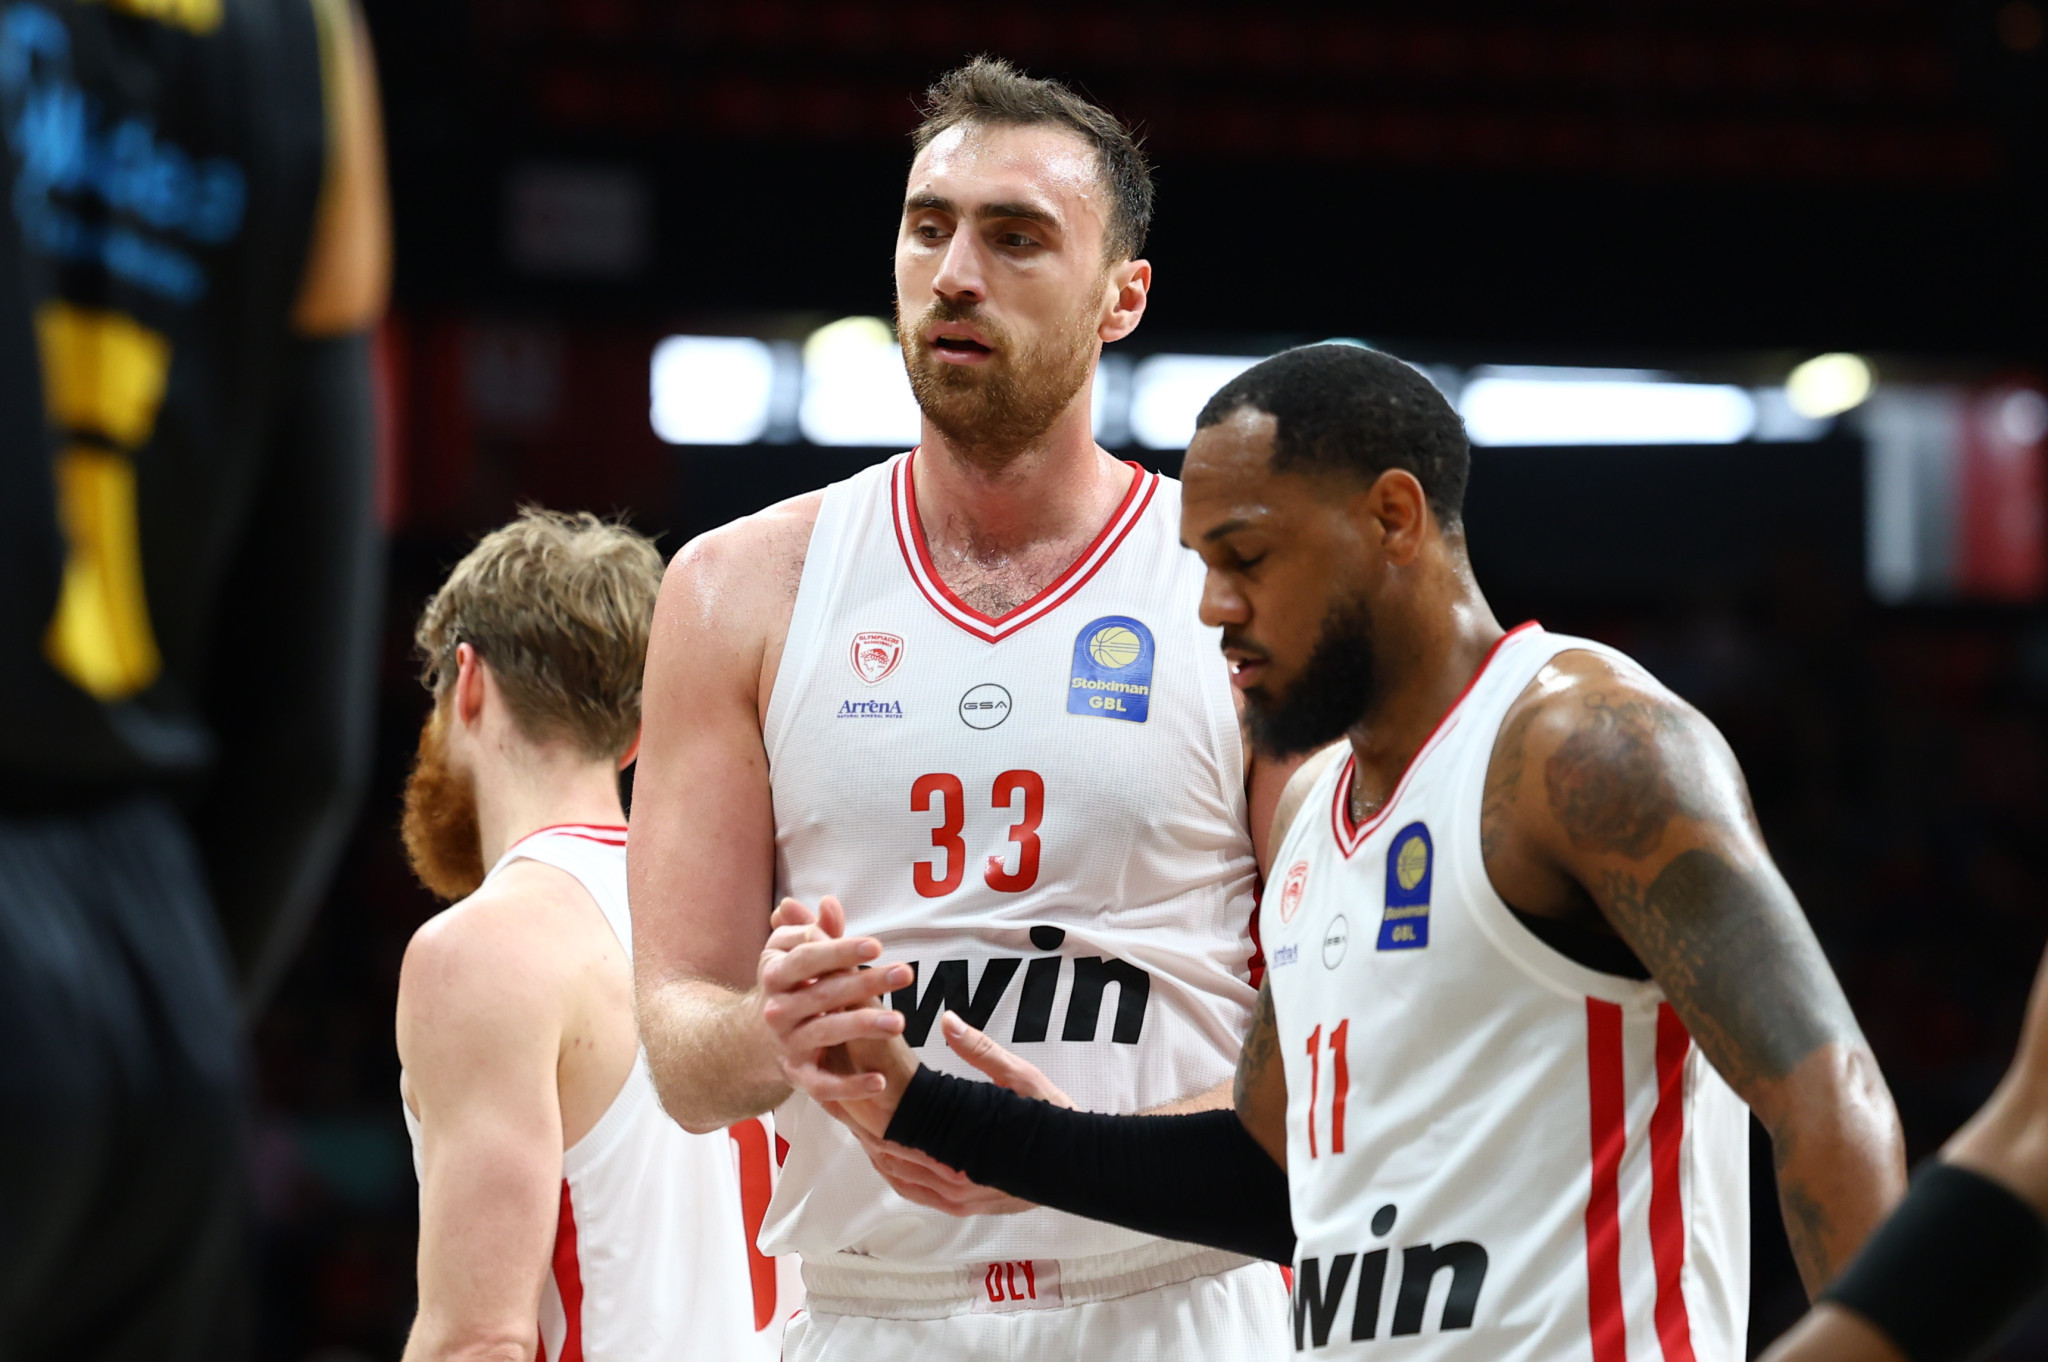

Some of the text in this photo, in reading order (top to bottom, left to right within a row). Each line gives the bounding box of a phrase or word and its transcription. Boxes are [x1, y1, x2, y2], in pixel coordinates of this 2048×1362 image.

[964, 700, 1008, 710] GSA
[1071, 677, 1149, 696] Stoiximan
[1088, 695, 1128, 713] GBL
[910, 769, 1044, 898] 33
[859, 925, 1150, 1047] win
[1306, 1018, 1349, 1159] 11
[1289, 1203, 1489, 1353] win
